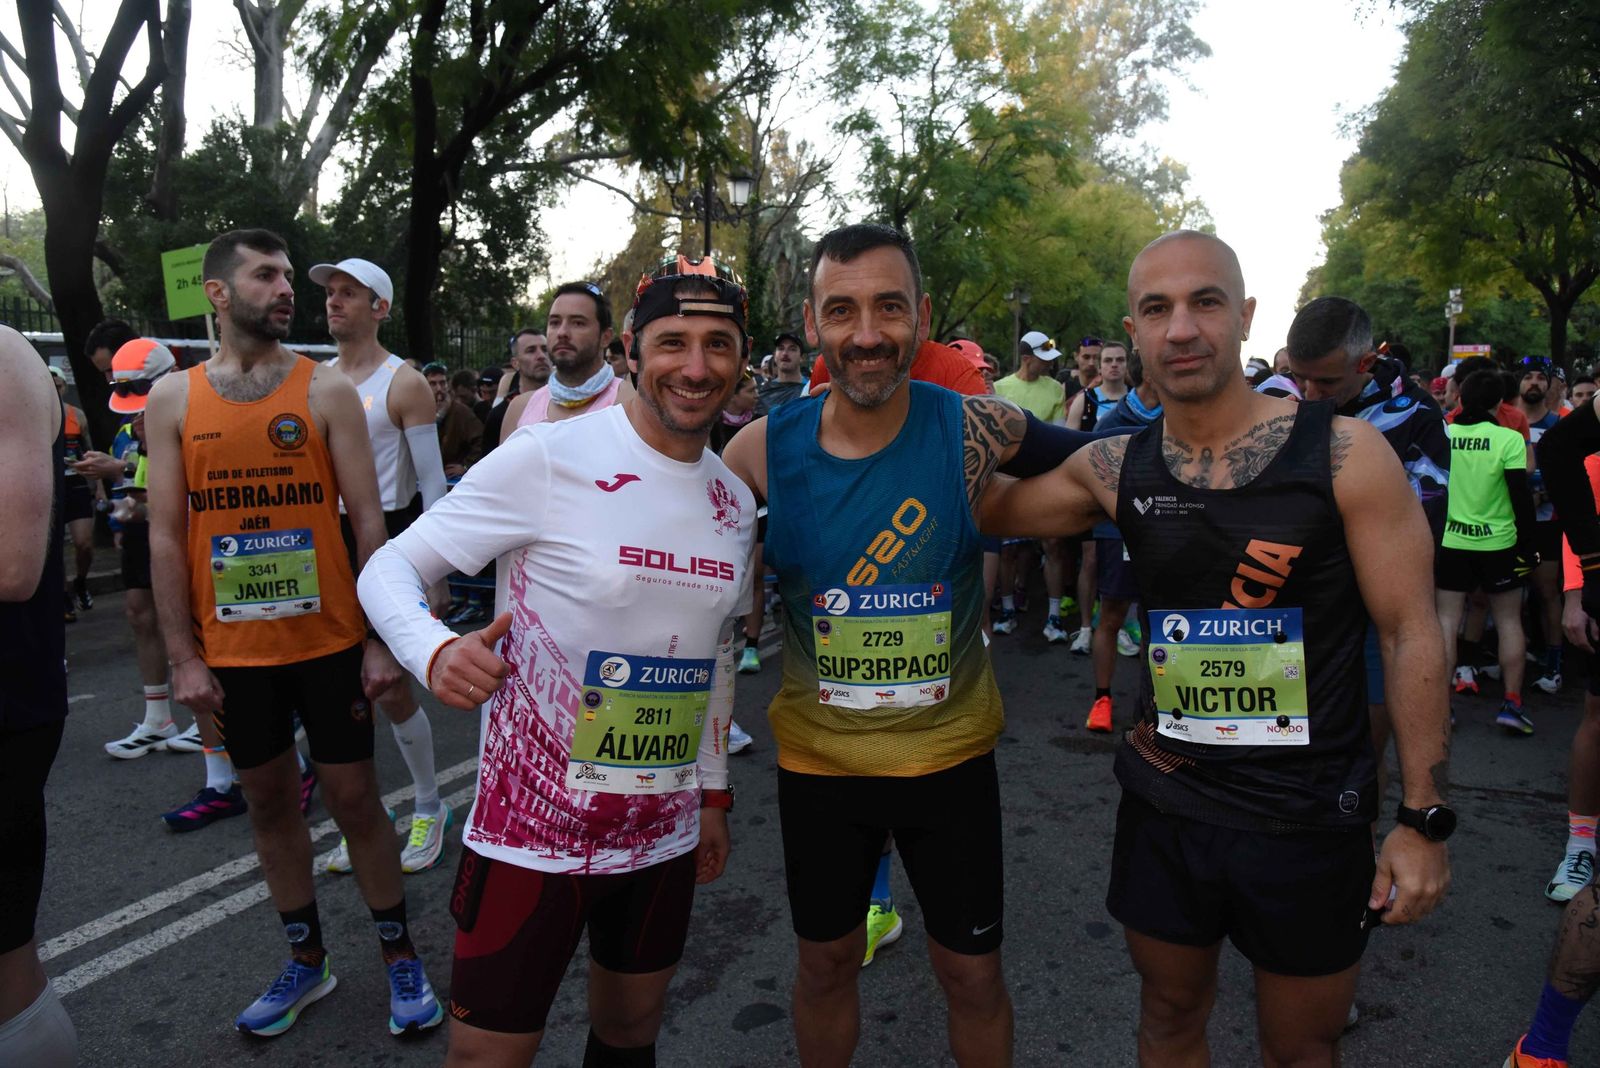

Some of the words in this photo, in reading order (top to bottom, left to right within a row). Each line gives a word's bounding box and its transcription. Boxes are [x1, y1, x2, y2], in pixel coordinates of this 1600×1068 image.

[176, 278, 189, 290] 2h
[192, 432, 222, 442] FASTER
[207, 469, 229, 481] CLUB
[231, 468, 243, 479] DE
[245, 466, 294, 478] ATLETISMO
[239, 514, 271, 530] JAÉN
[244, 534, 301, 551] ZURICH
[248, 562, 278, 577] 3341
[618, 545, 735, 582] SOLISS
[635, 574, 672, 585] Seguros
[676, 580, 701, 590] desde
[1221, 539, 1303, 610] CIA
[234, 578, 300, 601] JAVIER
[859, 592, 935, 610] ZURICH
[1198, 619, 1282, 636] ZURICH
[862, 630, 904, 648] 2729
[817, 651, 950, 681] SUP3RPACO
[1200, 660, 1246, 678] 2579
[638, 666, 704, 685] ZURICH
[1175, 684, 1278, 713] VICTOR
[633, 707, 672, 725] 2811
[1172, 723, 1189, 732] asics
[595, 726, 689, 762] ÁLVARO
